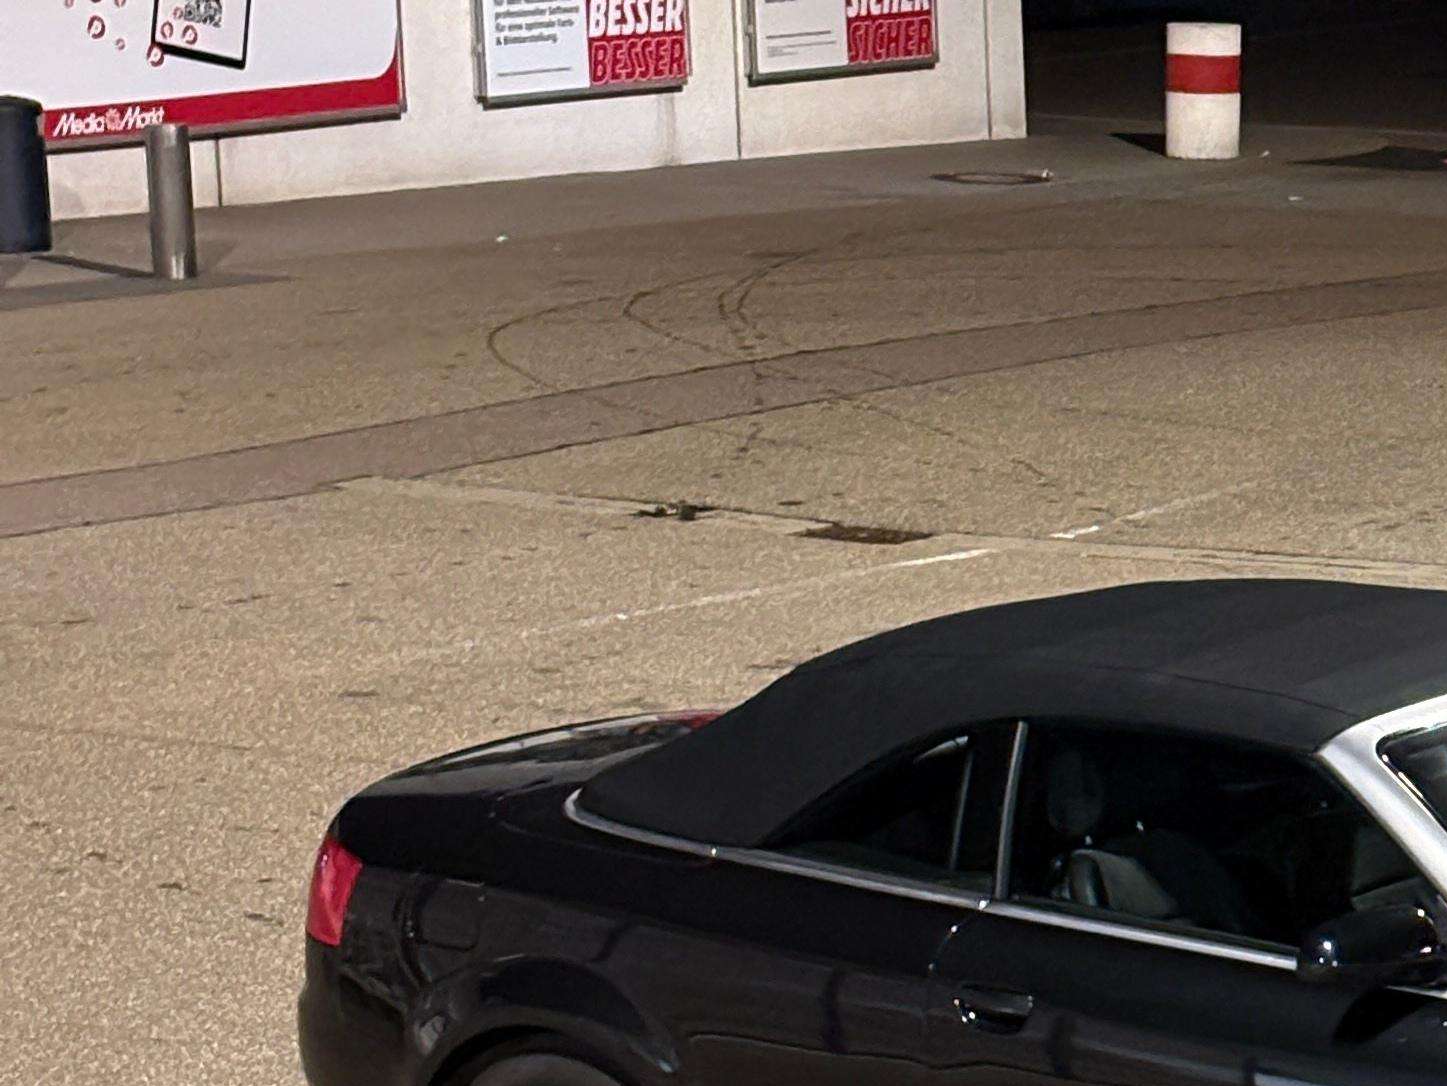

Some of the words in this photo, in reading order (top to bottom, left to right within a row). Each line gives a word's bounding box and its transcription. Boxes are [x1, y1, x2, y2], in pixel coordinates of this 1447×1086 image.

[589, 0, 684, 38] BESSER
[849, 15, 933, 65] SICHER
[591, 35, 687, 85] BESSER
